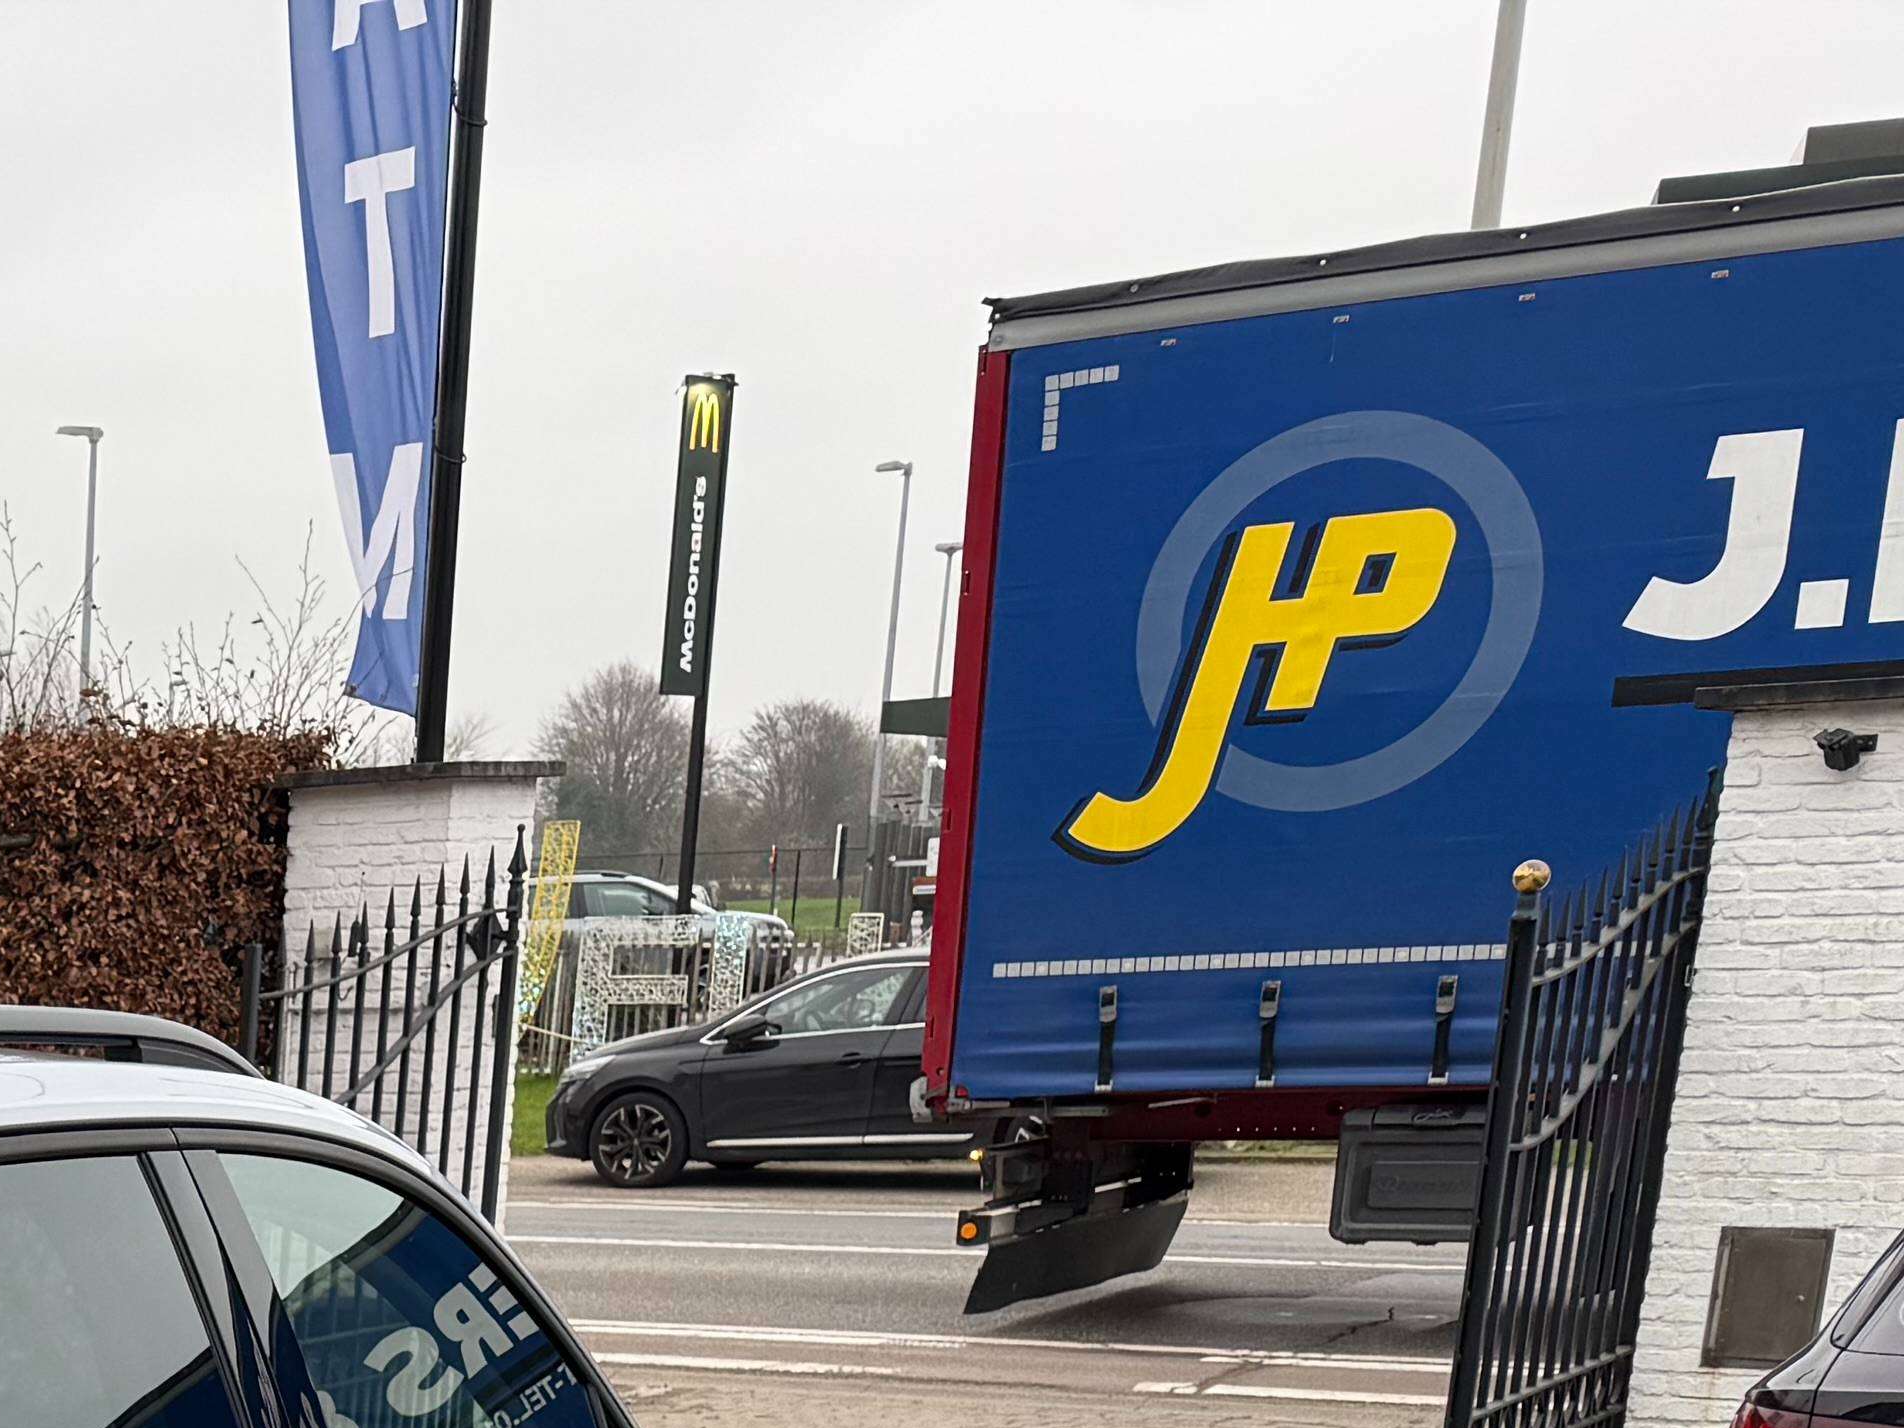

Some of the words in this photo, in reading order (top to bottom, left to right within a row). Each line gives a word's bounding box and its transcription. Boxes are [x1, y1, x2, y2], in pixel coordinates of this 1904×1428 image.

[329, 0, 428, 620] TM
[679, 475, 708, 674] McDonald's
[1622, 418, 1904, 642] J.
